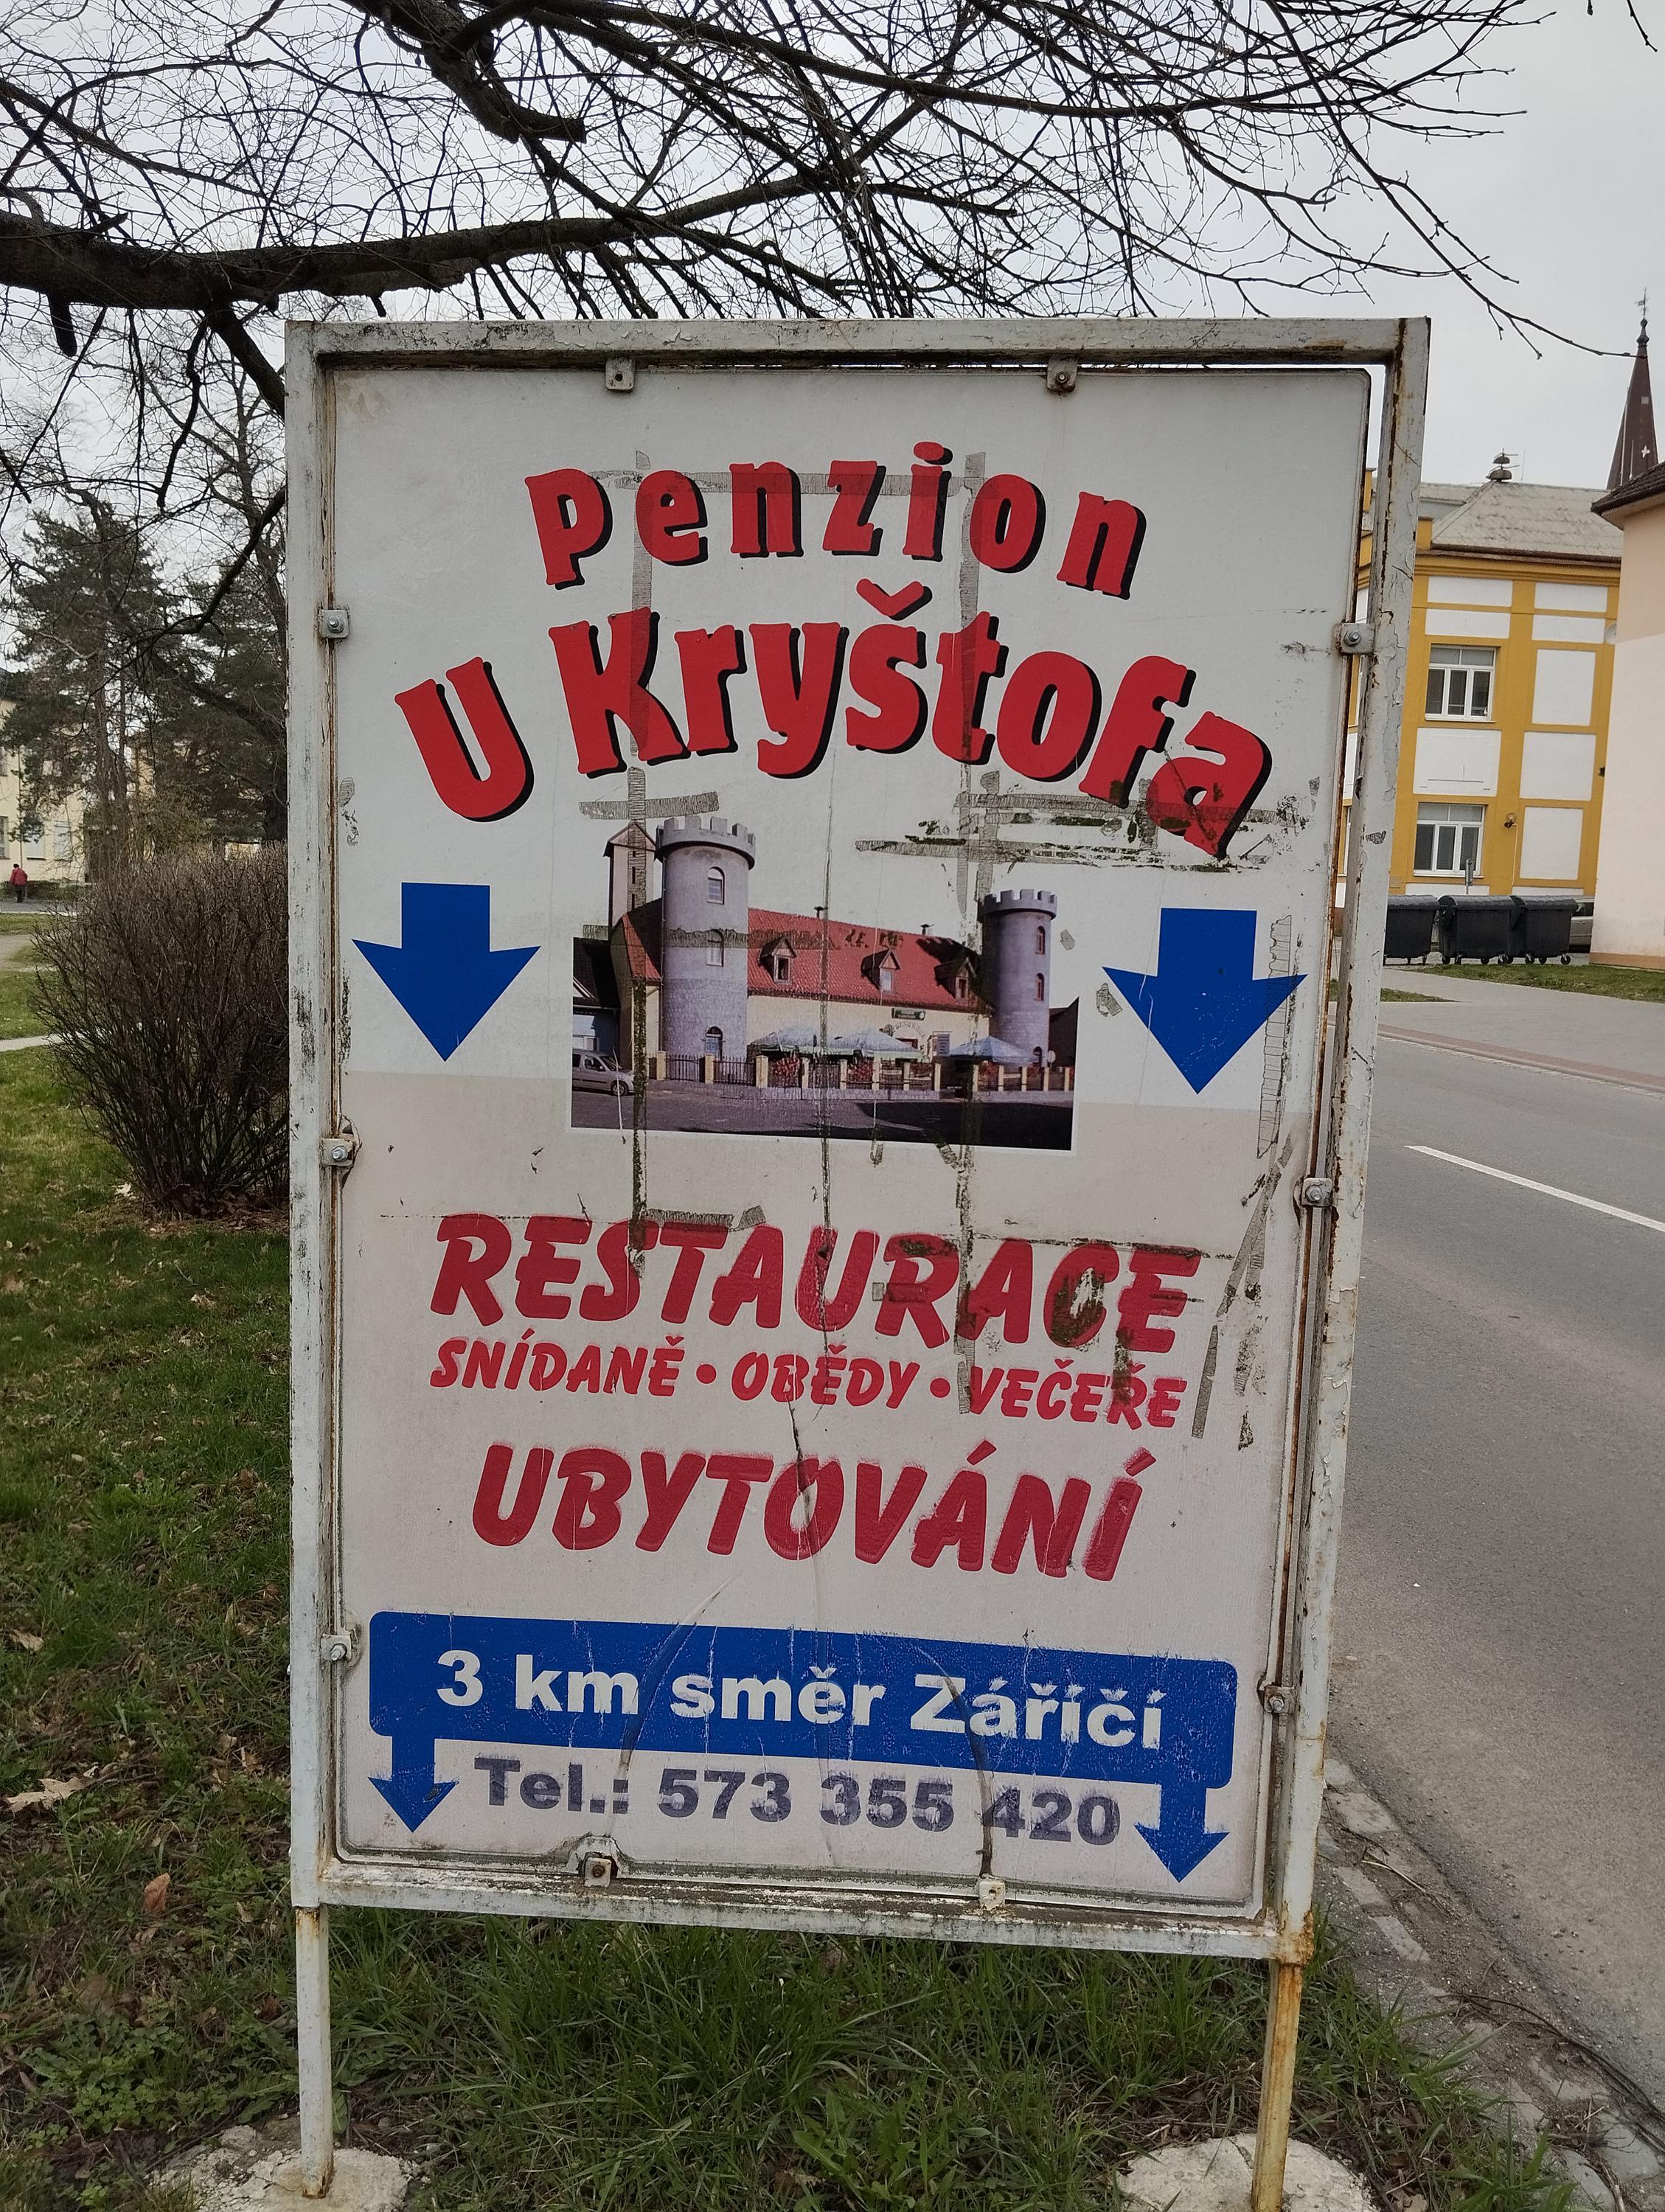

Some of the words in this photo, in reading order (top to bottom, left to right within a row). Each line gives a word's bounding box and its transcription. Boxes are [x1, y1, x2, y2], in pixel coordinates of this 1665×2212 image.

[394, 655, 535, 823] U
[549, 579, 1273, 860] Kryštofa
[429, 1213, 1204, 1354] RESTAURACE
[430, 1329, 685, 1397] SNÍDANĚ
[730, 1344, 920, 1410] OBĚDY
[970, 1357, 1188, 1430] VEČEŘE
[472, 1440, 1157, 1581] UBYTOVÁNÍ
[437, 1650, 483, 1707] 3
[515, 1654, 639, 1715] km
[670, 1666, 886, 1724] směr
[910, 1674, 1165, 1749] Záříčí
[475, 1758, 629, 1814] Tel.:
[658, 1769, 792, 1823] 573
[820, 1774, 954, 1832] 355
[984, 1787, 1120, 1845] 420
